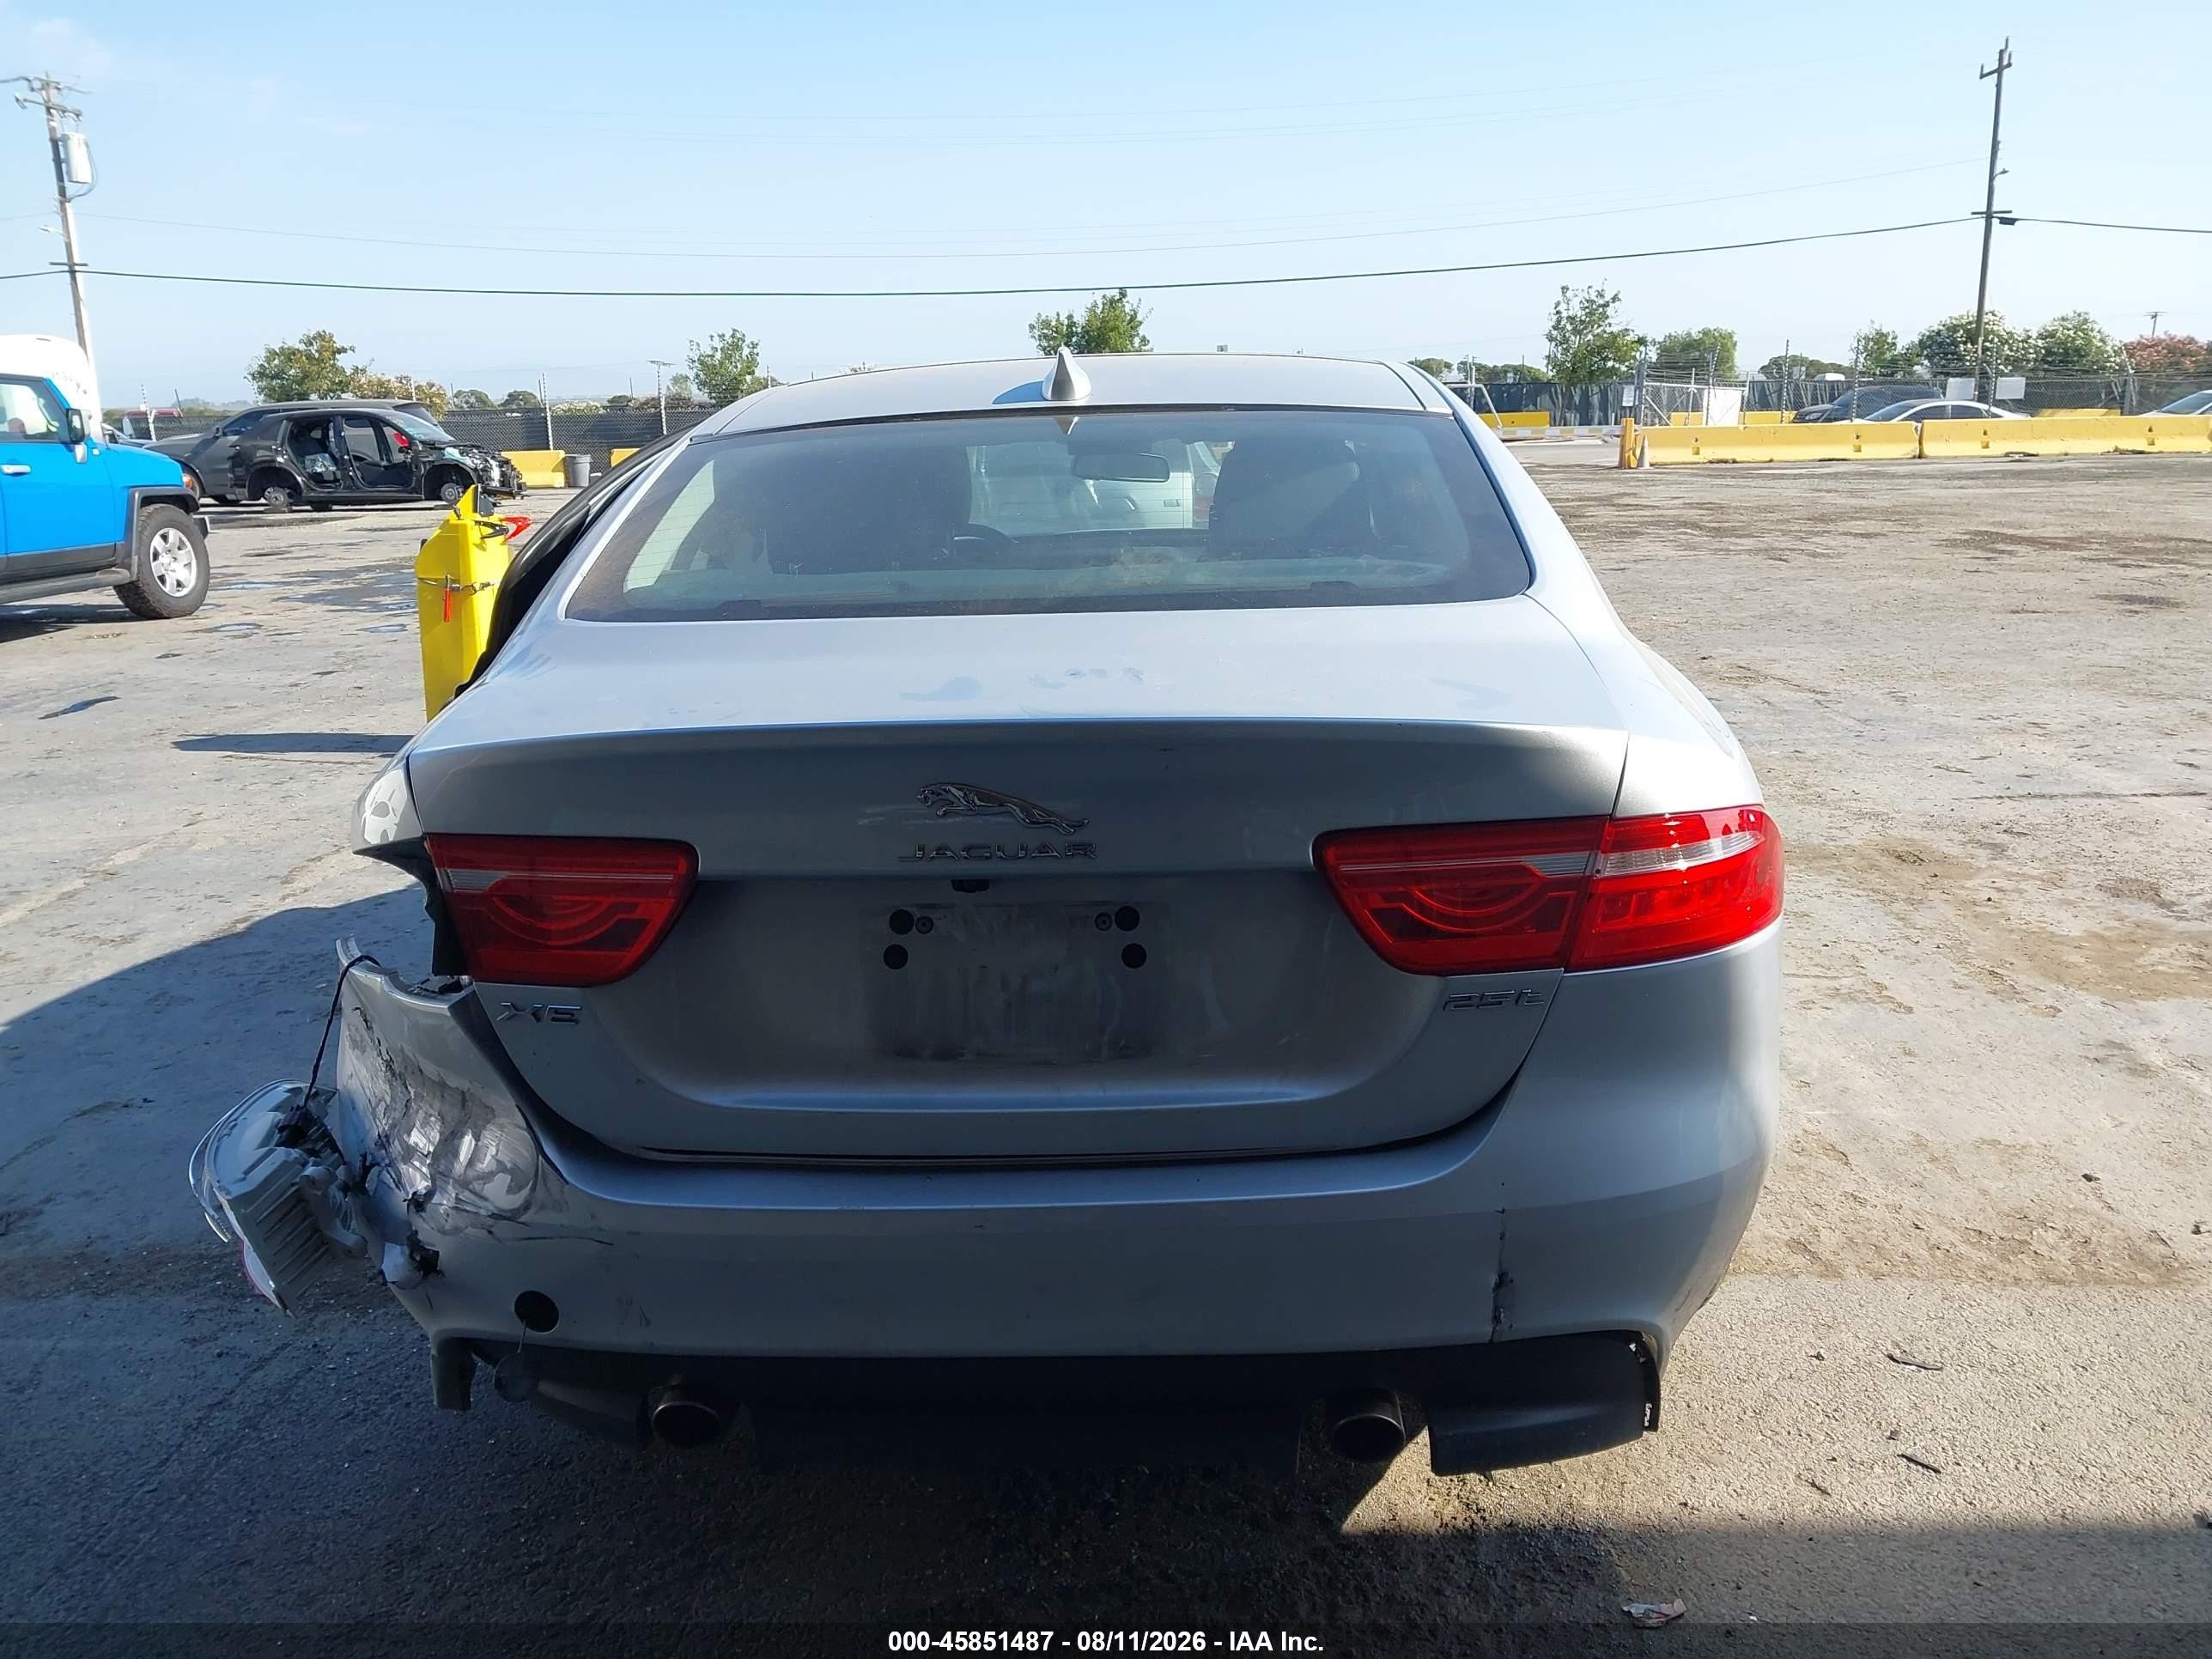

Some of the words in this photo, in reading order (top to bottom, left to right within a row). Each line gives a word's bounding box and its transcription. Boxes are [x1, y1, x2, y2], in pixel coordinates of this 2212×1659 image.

[897, 842, 1097, 861] JAGUAR
[1443, 988, 1546, 1012] 25t
[496, 1002, 582, 1024] XE
